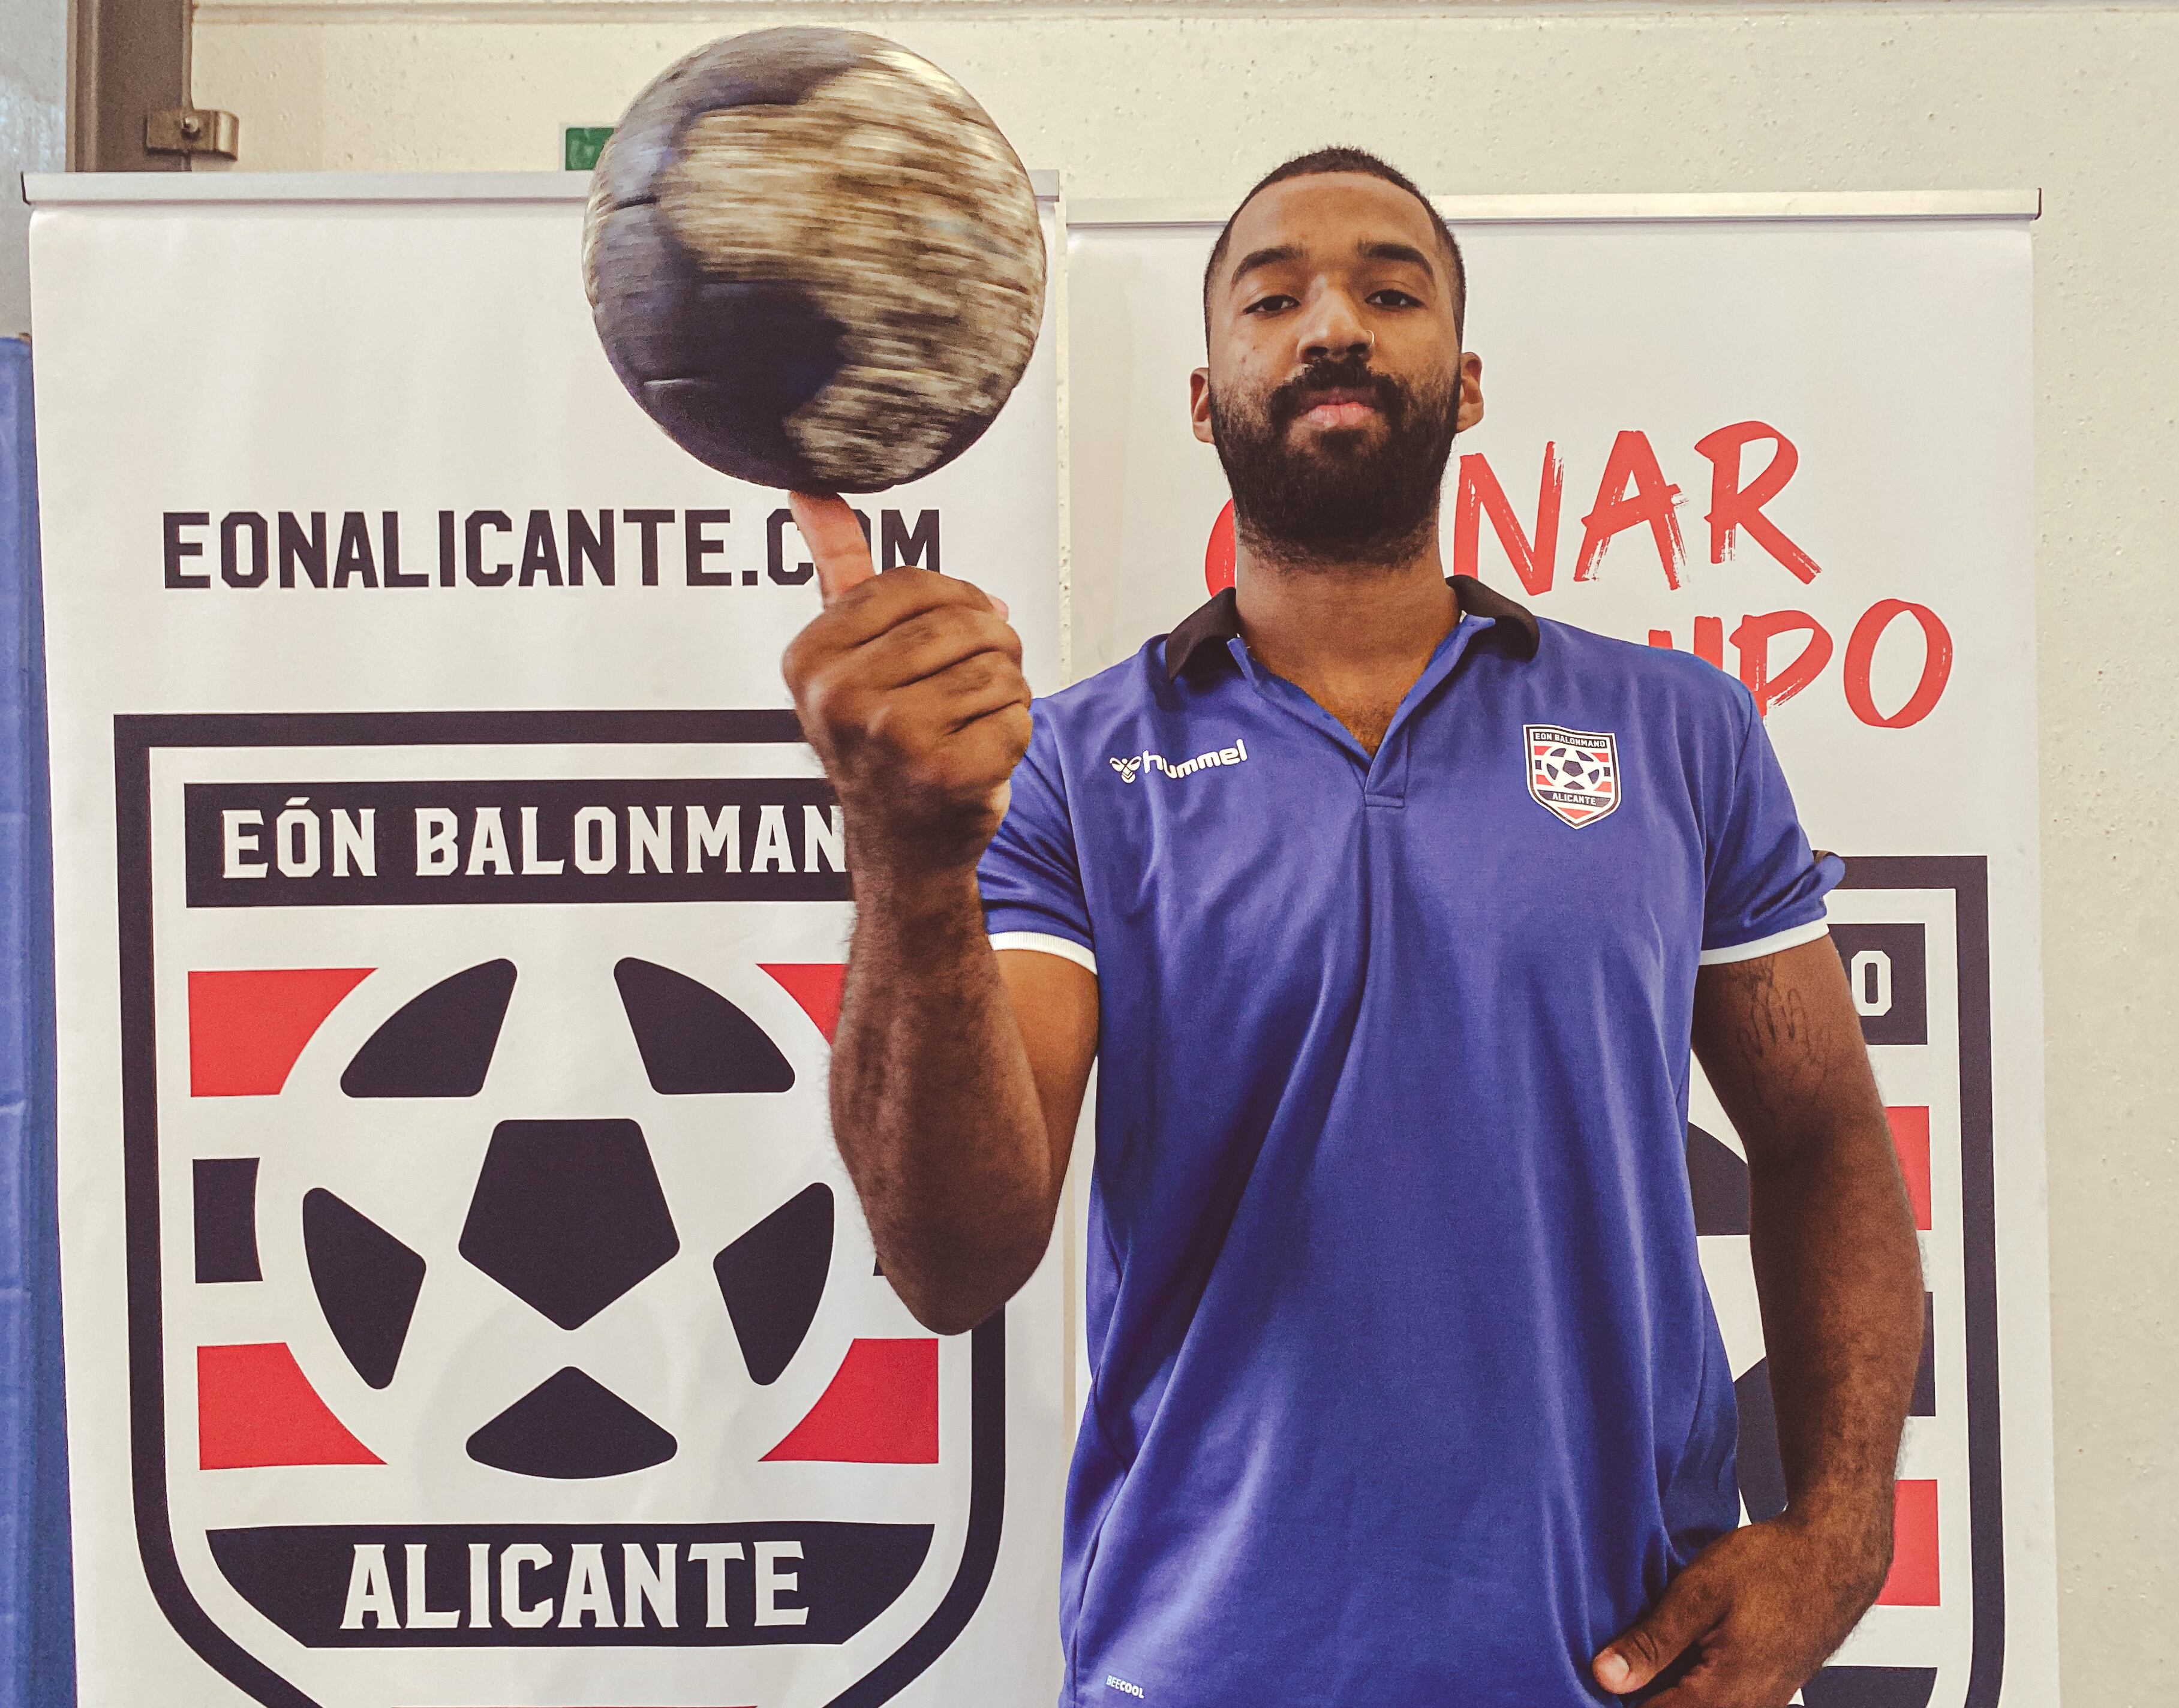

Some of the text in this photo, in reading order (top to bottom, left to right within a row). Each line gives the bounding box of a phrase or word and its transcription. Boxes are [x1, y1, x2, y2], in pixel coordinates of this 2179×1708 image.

[1205, 420, 1823, 600] NAR
[1142, 738, 1248, 778] hummel
[1555, 733, 1606, 748] BALONMANO
[1552, 792, 1597, 805] ALICANTE
[221, 797, 847, 879] EÓN BALONMAN
[339, 1540, 809, 1629] ALICANTE
[1105, 1674, 1145, 1699] BEECOOL
